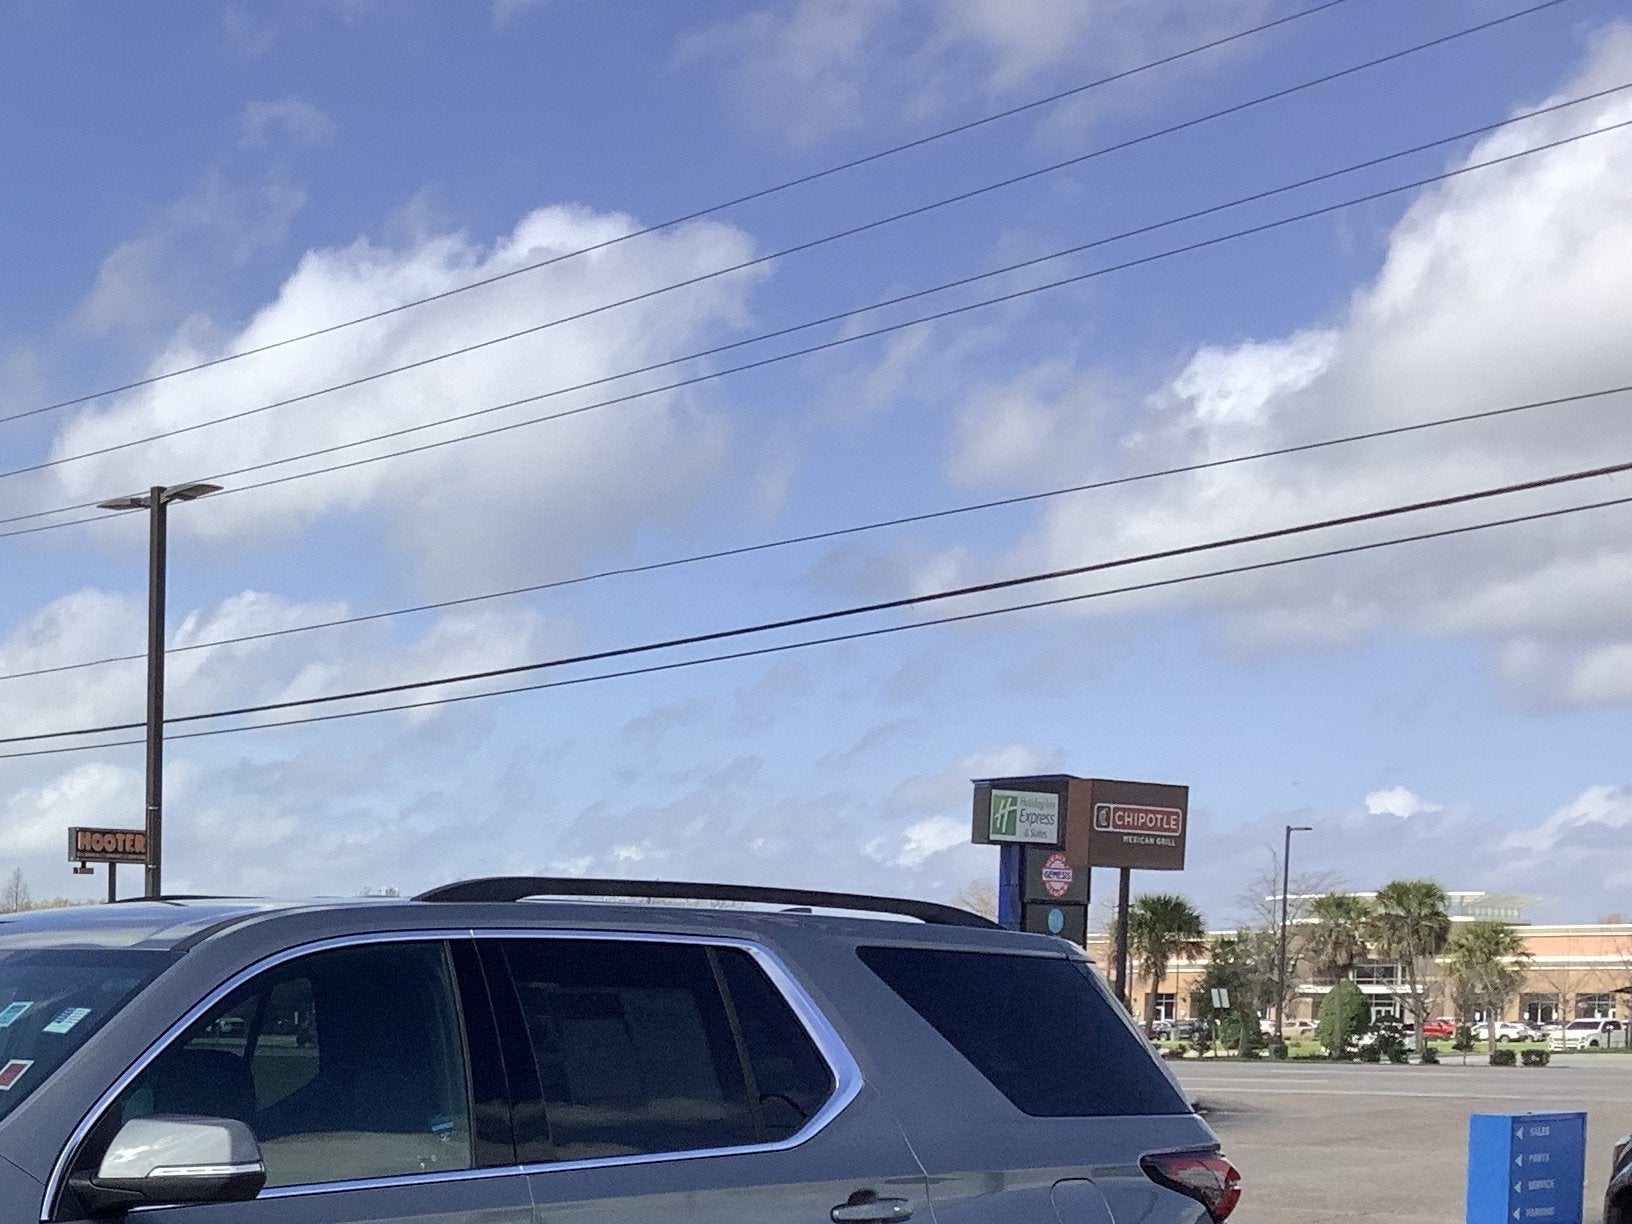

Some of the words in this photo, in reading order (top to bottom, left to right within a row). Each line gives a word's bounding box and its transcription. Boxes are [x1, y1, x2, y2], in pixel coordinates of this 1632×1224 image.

[1019, 808, 1055, 827] Express
[1114, 811, 1178, 829] CHIPOTLE
[77, 831, 146, 853] HOOTER
[1123, 835, 1154, 845] MEXICAN
